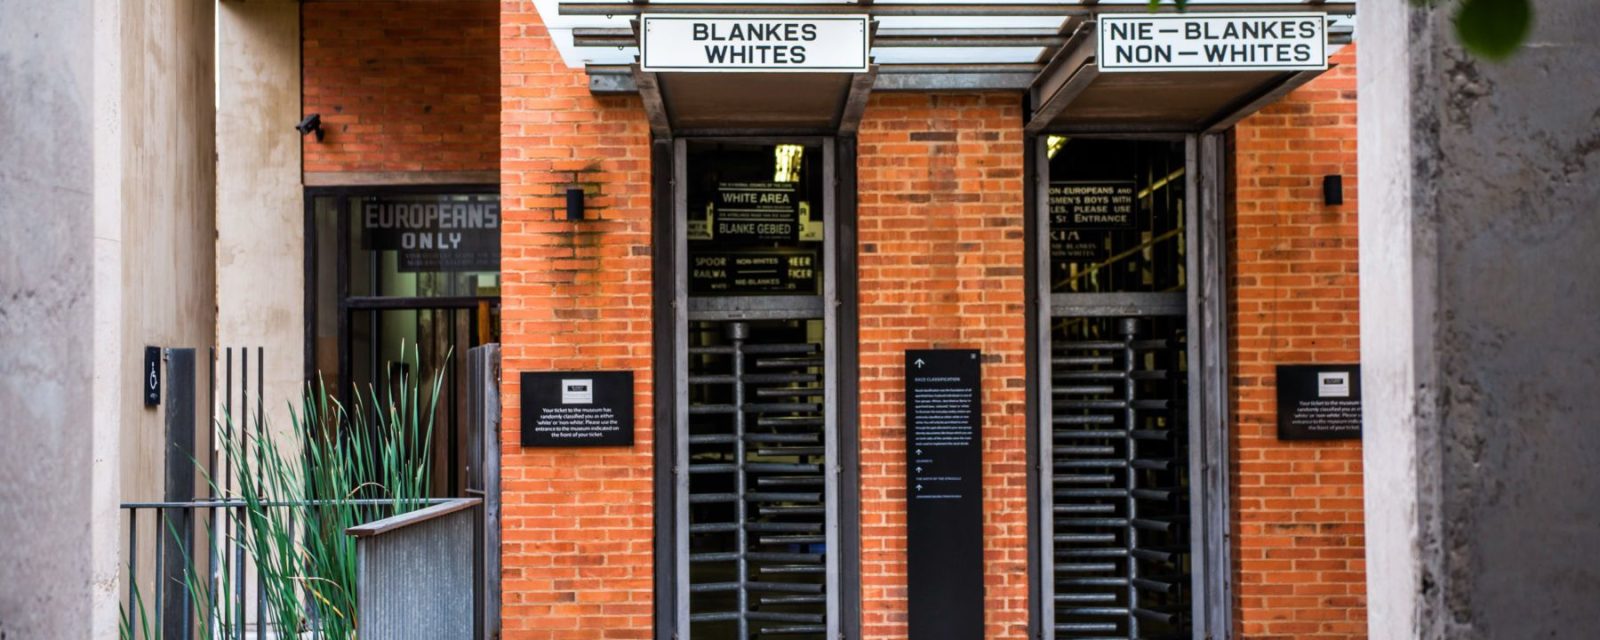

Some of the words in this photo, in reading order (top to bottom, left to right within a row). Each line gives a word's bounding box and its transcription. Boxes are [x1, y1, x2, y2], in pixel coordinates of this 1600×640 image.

[692, 23, 817, 41] BLANKES
[704, 45, 806, 64] WHITES
[1049, 187, 1114, 195] ON-EUROPEANS
[722, 193, 757, 203] WHITE
[760, 193, 790, 203] AREA
[1050, 196, 1081, 205] SMEN'S
[1084, 196, 1109, 204] BOYS
[1111, 196, 1132, 204] WITH
[1050, 205, 1069, 213] LES.
[1074, 205, 1108, 213] PLEASE
[1113, 205, 1131, 213] USE
[365, 203, 498, 229] EUROPEANS
[719, 223, 755, 234] BLANKE
[757, 223, 791, 234] GEBIED
[401, 232, 462, 249] ONLY
[695, 257, 727, 266] SPOOR
[693, 270, 727, 278] RAILWA
[788, 269, 812, 278] FICER
